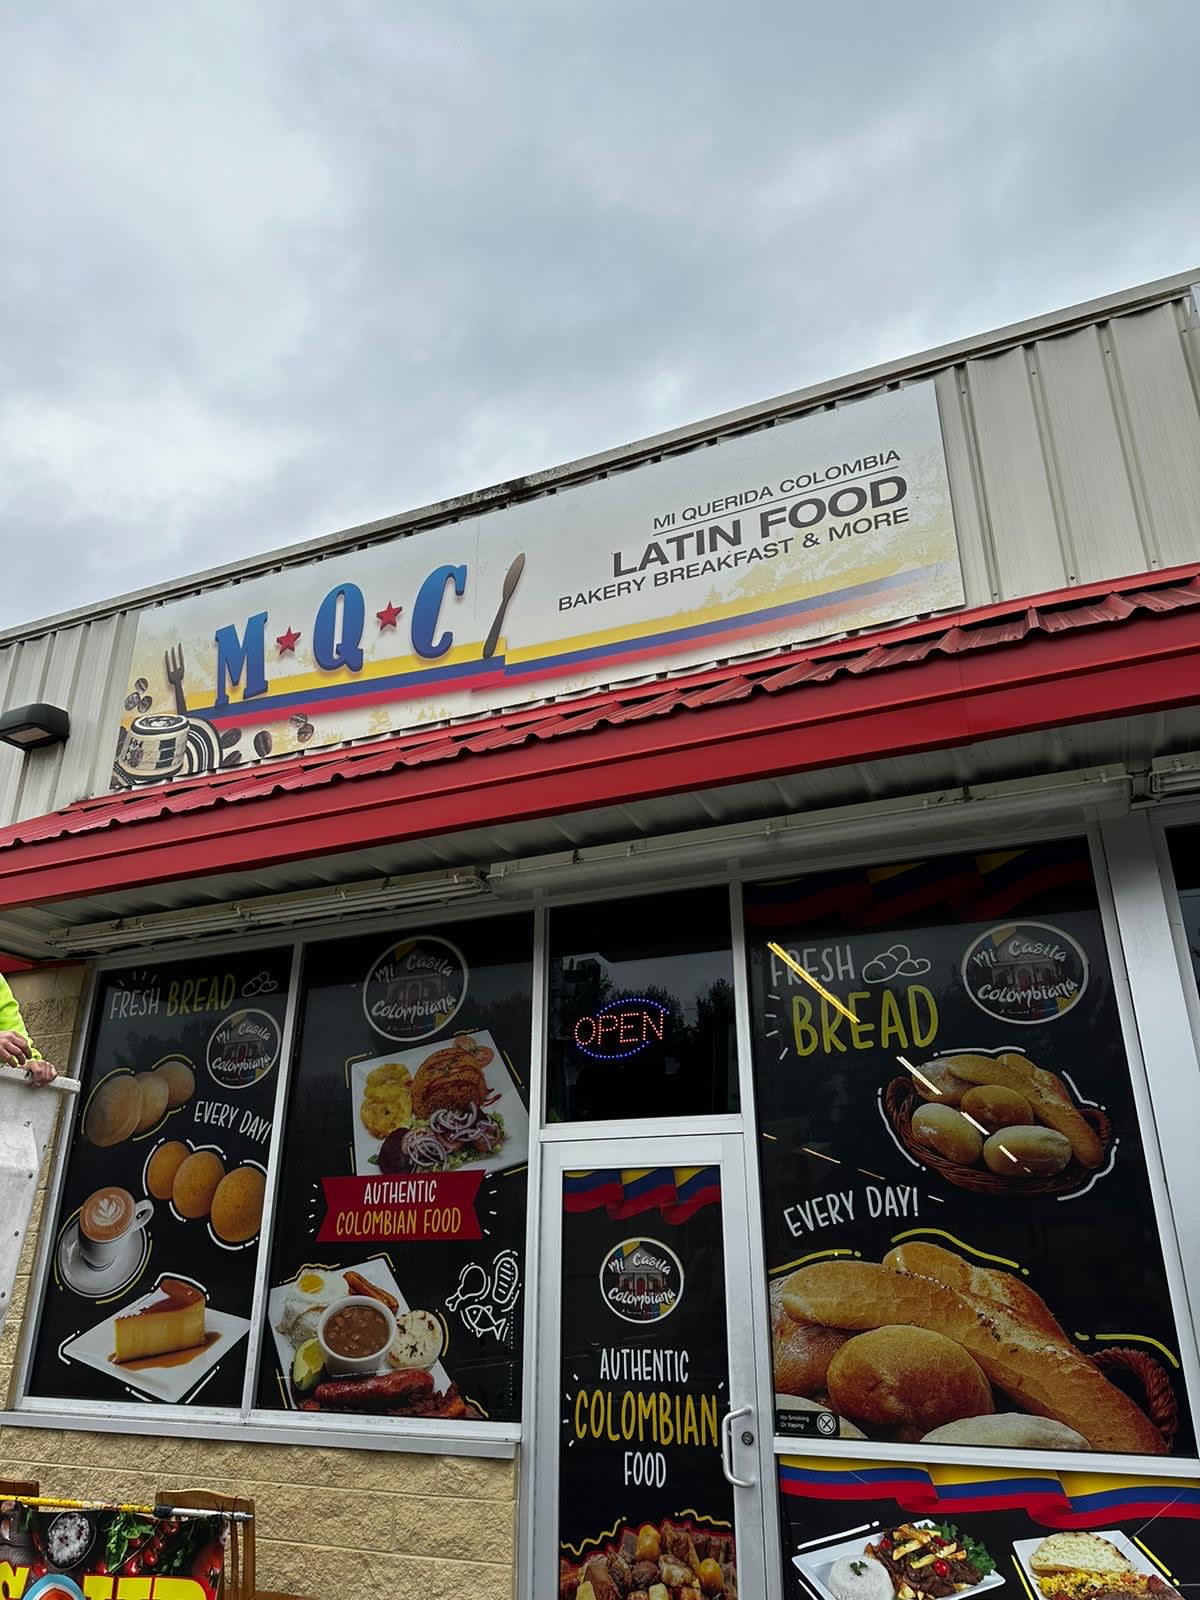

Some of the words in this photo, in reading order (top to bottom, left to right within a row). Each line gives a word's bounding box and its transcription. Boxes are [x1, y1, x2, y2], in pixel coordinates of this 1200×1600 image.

[653, 512, 676, 530] MI
[682, 486, 774, 521] QUERIDA
[779, 450, 901, 493] COLOMBIA
[612, 519, 742, 577] LATIN
[759, 475, 908, 538] FOOD
[558, 577, 646, 611] BAKERY
[653, 537, 794, 588] BREAKFAST
[802, 531, 820, 549] &
[828, 507, 910, 542] MORE
[374, 963, 395, 983] Mi
[407, 954, 454, 977] Casita
[770, 944, 855, 987] FRESH
[972, 948, 997, 968] Mi
[1008, 939, 1068, 962] Casita
[110, 987, 160, 1019] FRESH
[166, 974, 236, 1017] BREAD
[371, 992, 456, 1025] Colombiana
[977, 977, 1079, 1008] Colombiana
[216, 1029, 230, 1044] Mi
[238, 1022, 271, 1041] Casita
[574, 1009, 664, 1046] OPEN
[792, 984, 939, 1057] BREAD
[211, 1053, 271, 1076] Colombiana
[194, 1101, 240, 1129] EVERY
[239, 1110, 273, 1145] DAY!
[363, 1179, 438, 1205] AUTHENTIC
[336, 1209, 417, 1236] COLOMBIAN
[424, 1207, 462, 1234] FOOD
[783, 1189, 856, 1238] EVERY
[865, 1185, 919, 1218] DAY!
[608, 1257, 625, 1274] Mi
[633, 1252, 672, 1275] Casita
[607, 1287, 677, 1311] Colombiana
[600, 1347, 690, 1383] AUTHENTIC
[574, 1389, 719, 1448] COLOMBIAN
[624, 1451, 667, 1488] FOOD
